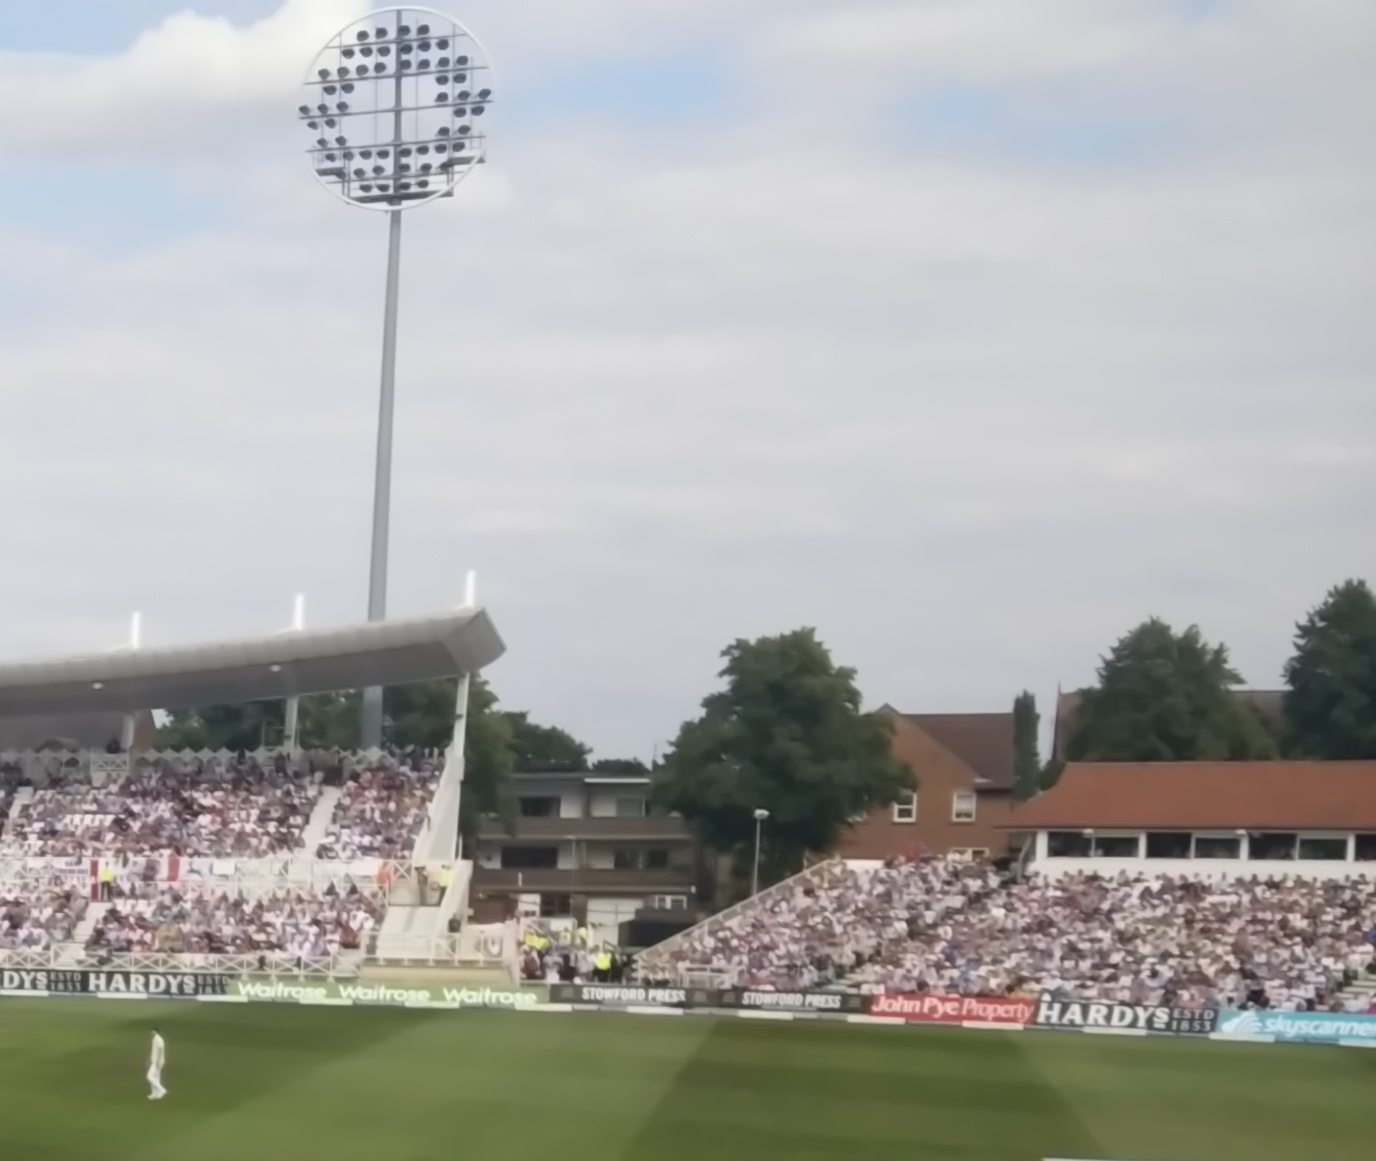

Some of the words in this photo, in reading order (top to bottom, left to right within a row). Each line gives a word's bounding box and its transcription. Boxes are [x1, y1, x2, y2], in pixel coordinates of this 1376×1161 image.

[237, 982, 327, 998] Waitrose
[338, 984, 430, 1001] Waitrose
[442, 987, 537, 1004] Waitrose
[581, 987, 645, 1000] STOWFORD
[648, 988, 686, 1001] PRESS
[742, 992, 803, 1005] STOWFORD
[805, 994, 841, 1007] PRESS
[871, 995, 921, 1013] John
[923, 997, 960, 1017] Pye
[961, 998, 1035, 1022] Property
[1173, 1009, 1215, 1019] ESTD
[1171, 1020, 1212, 1032] 1853
